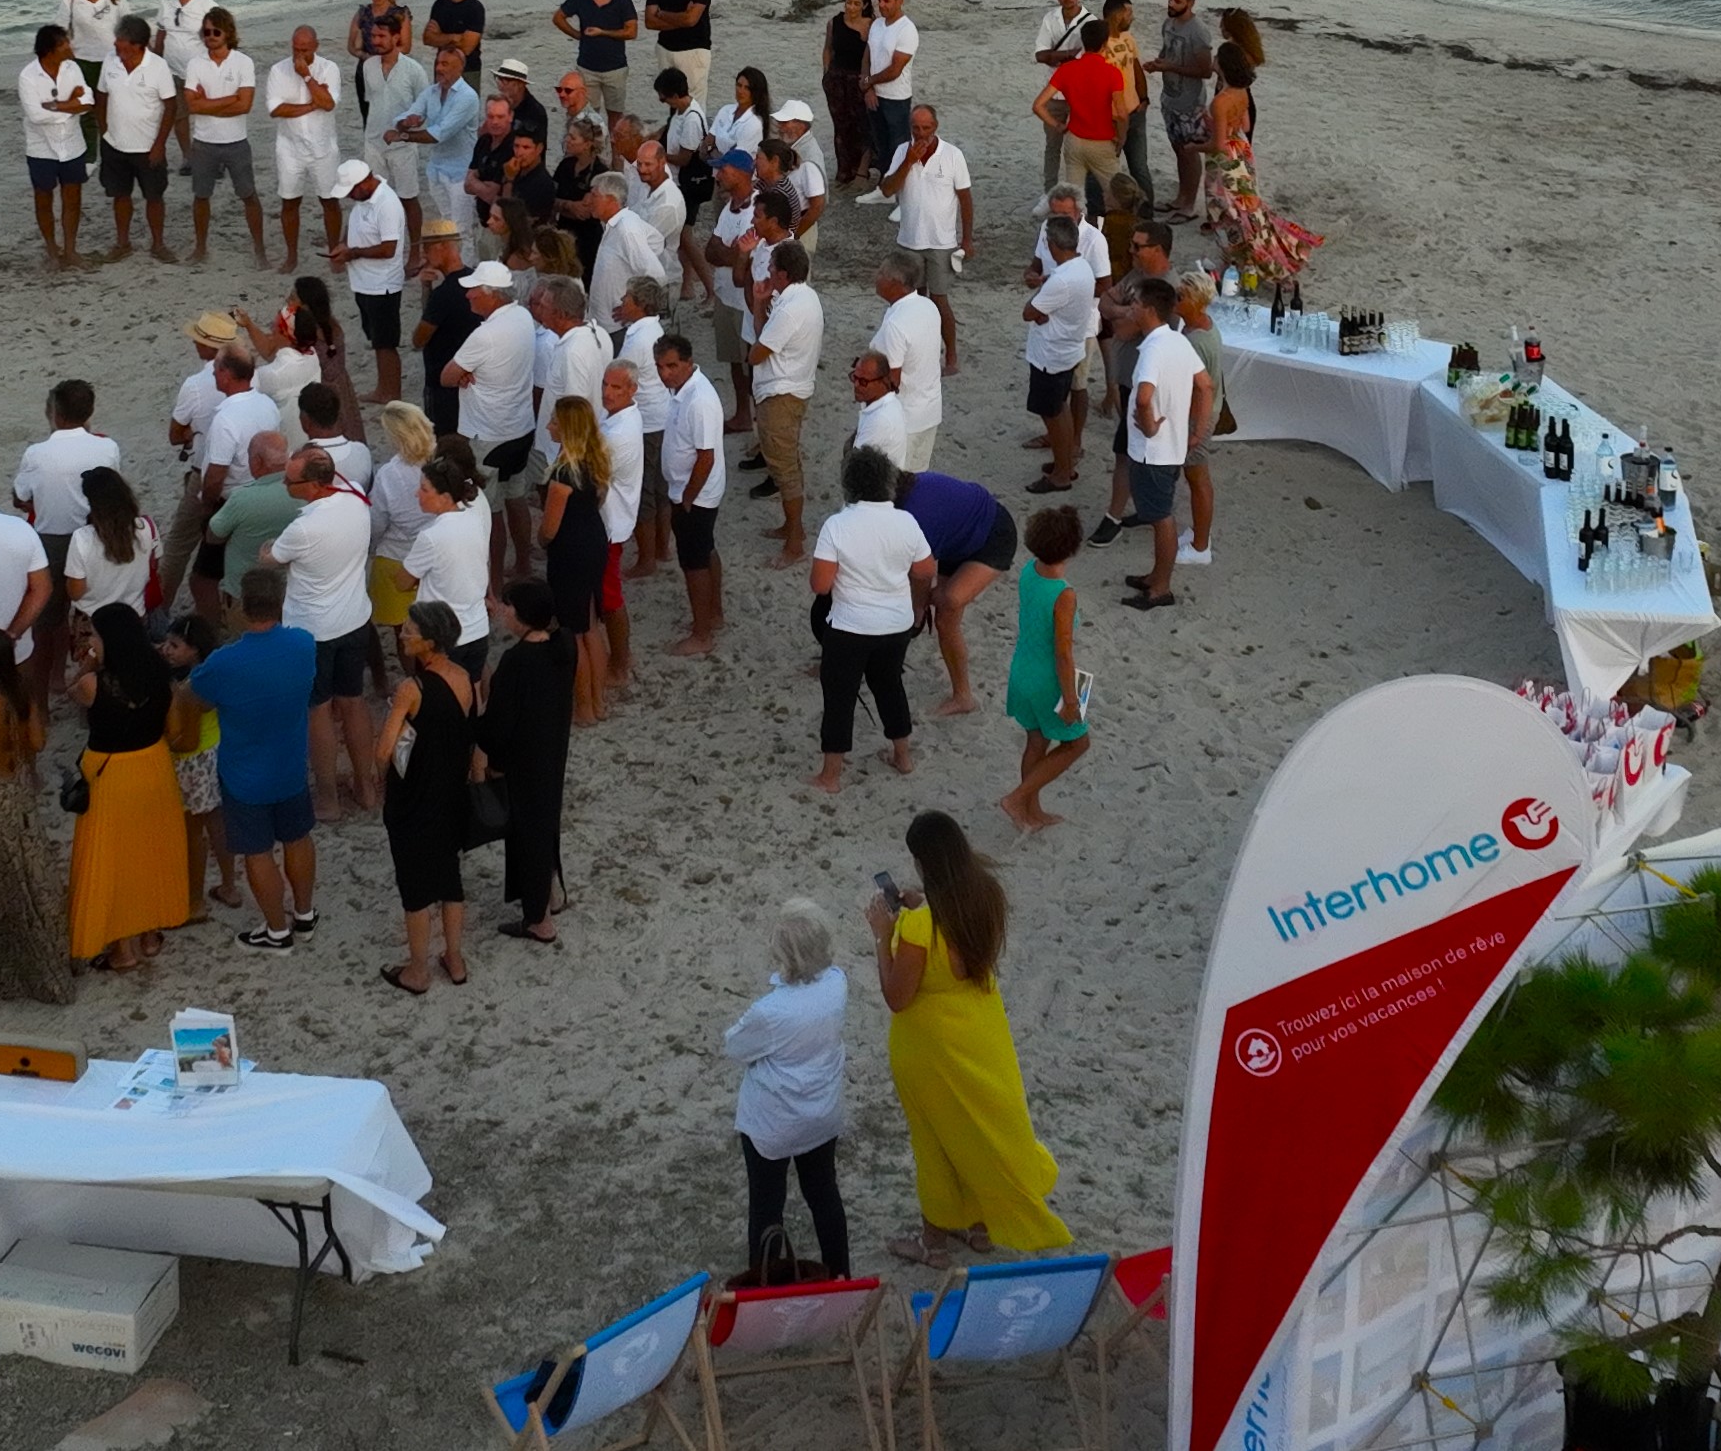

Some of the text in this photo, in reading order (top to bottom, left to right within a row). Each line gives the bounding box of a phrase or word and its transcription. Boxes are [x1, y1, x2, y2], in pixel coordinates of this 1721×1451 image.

[1266, 832, 1501, 943] Interhome
[1276, 932, 1506, 1037] Trouvez ici la maison de rêve
[1290, 1034, 1327, 1064] pour
[1327, 1021, 1358, 1043] vos
[1357, 985, 1437, 1028] vacances
[72, 1342, 127, 1359] wecovi
